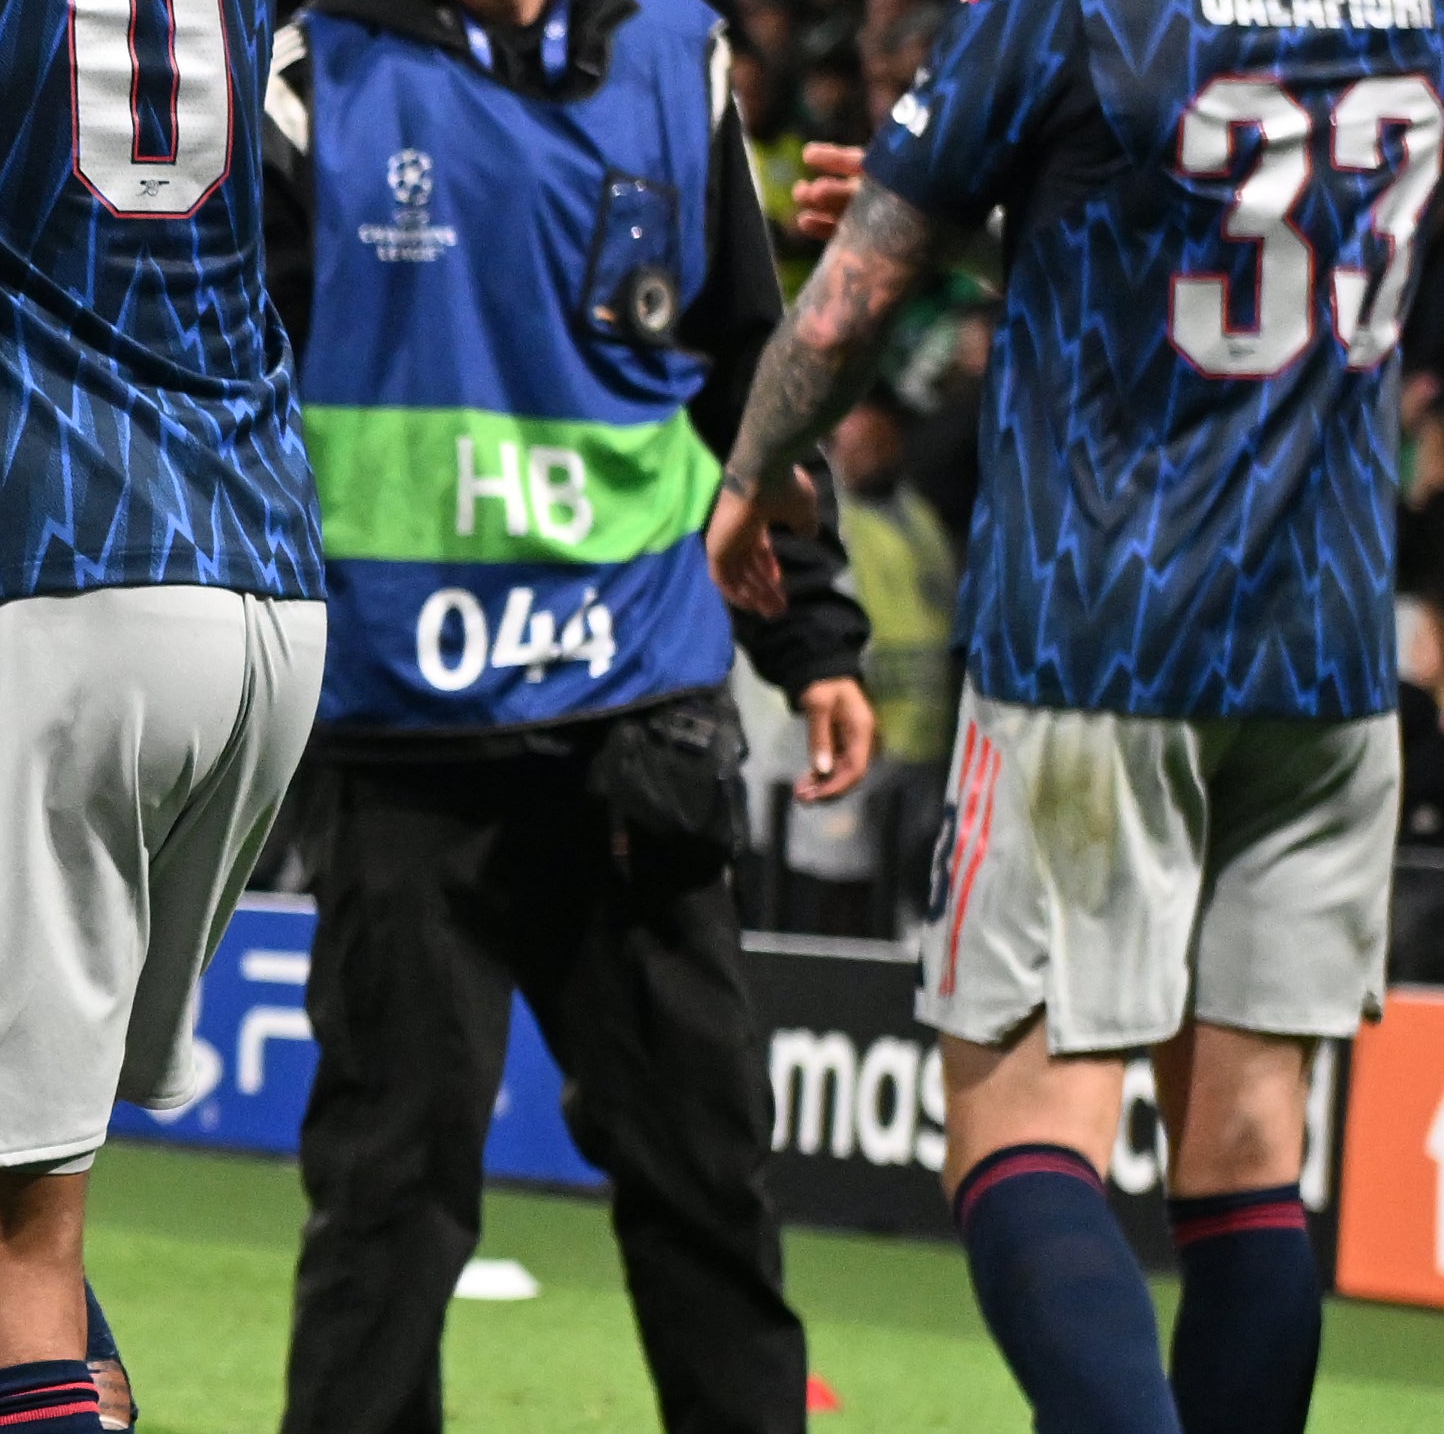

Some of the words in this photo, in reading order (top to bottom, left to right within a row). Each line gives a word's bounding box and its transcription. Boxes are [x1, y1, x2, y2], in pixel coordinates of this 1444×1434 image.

[1170, 74, 1444, 380] 33
[456, 436, 594, 546] HB
[416, 586, 617, 692] 044
